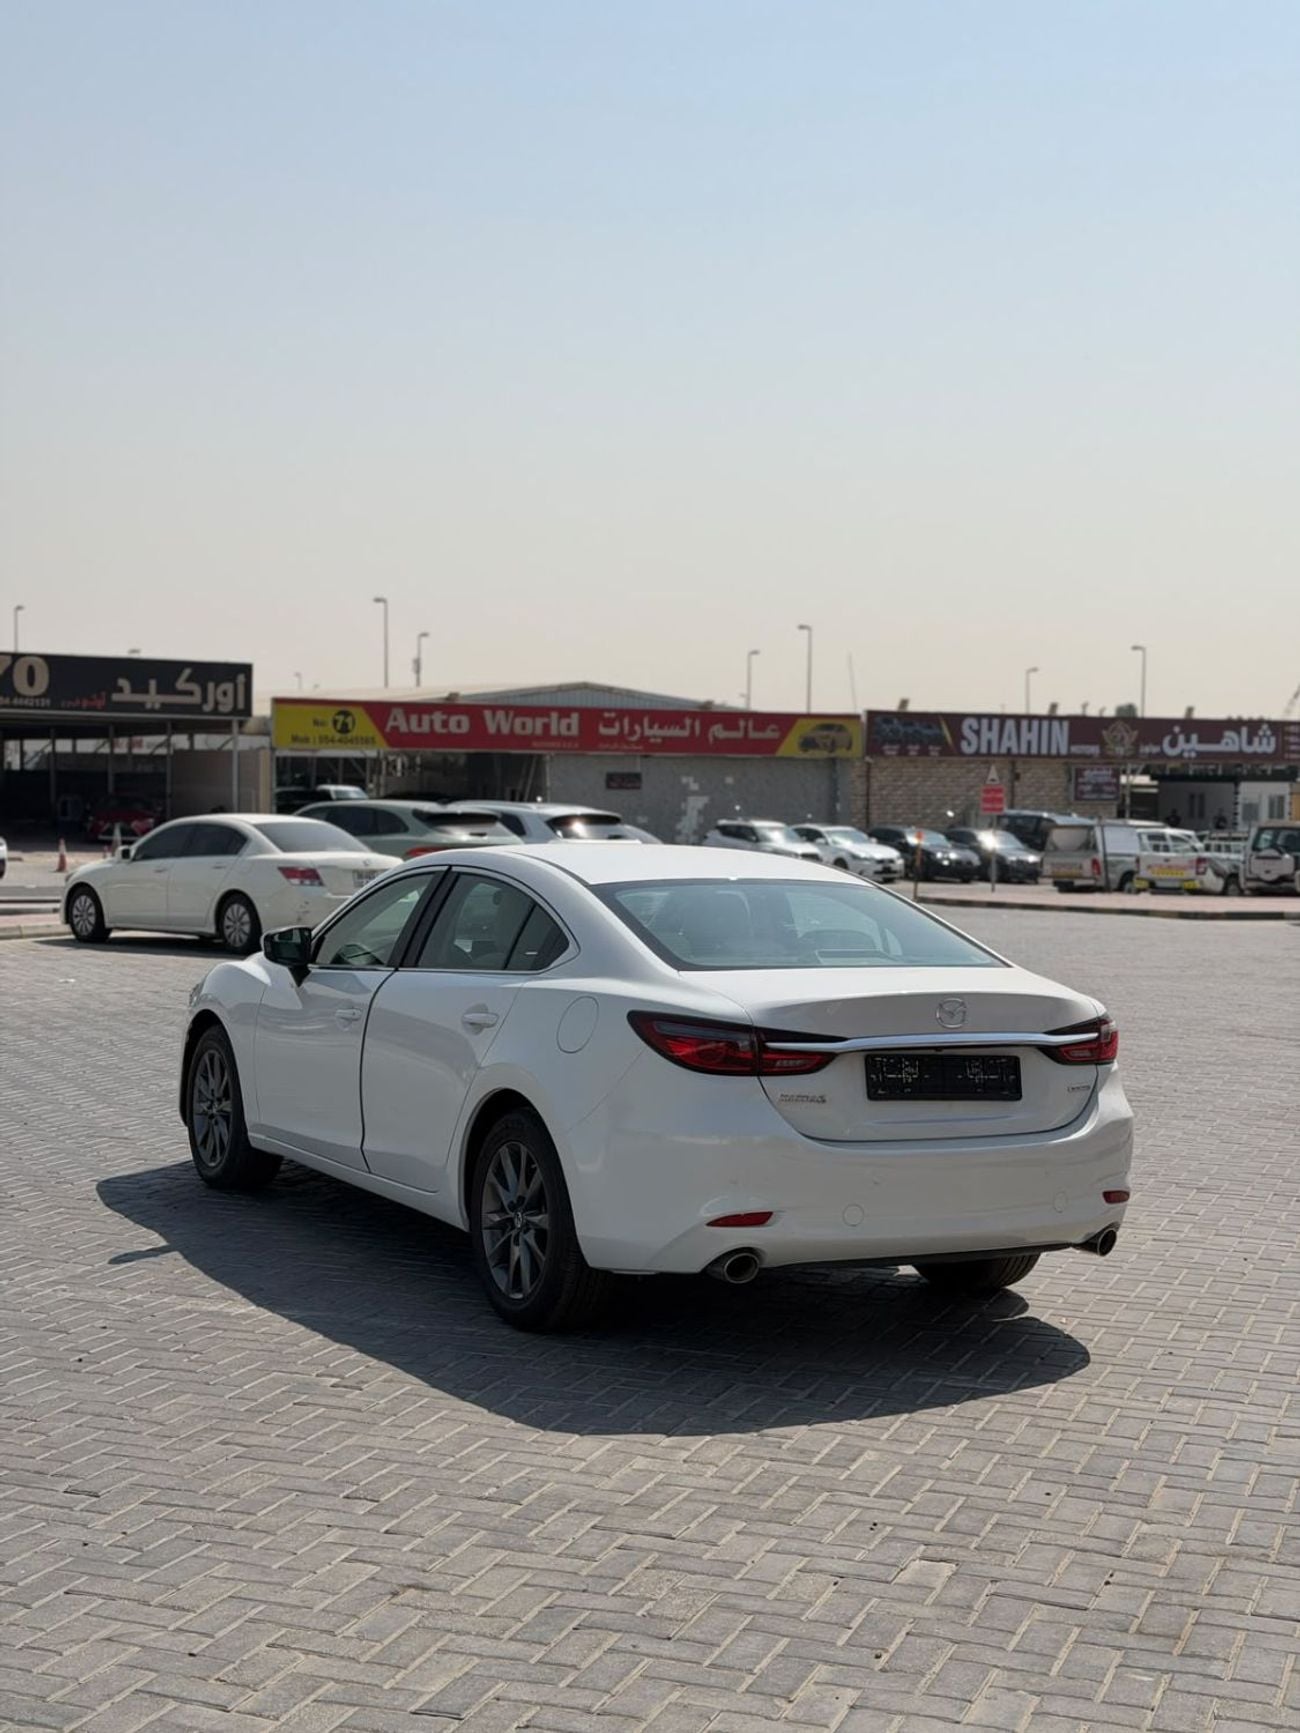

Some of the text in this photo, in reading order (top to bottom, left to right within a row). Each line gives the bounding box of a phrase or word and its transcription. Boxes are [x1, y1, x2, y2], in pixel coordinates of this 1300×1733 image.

[386, 708, 470, 734] Auto
[484, 710, 579, 737] World
[598, 711, 780, 743] عالم السيارات
[961, 718, 1070, 756] SHAHIN
[1162, 723, 1276, 758] شاهين
